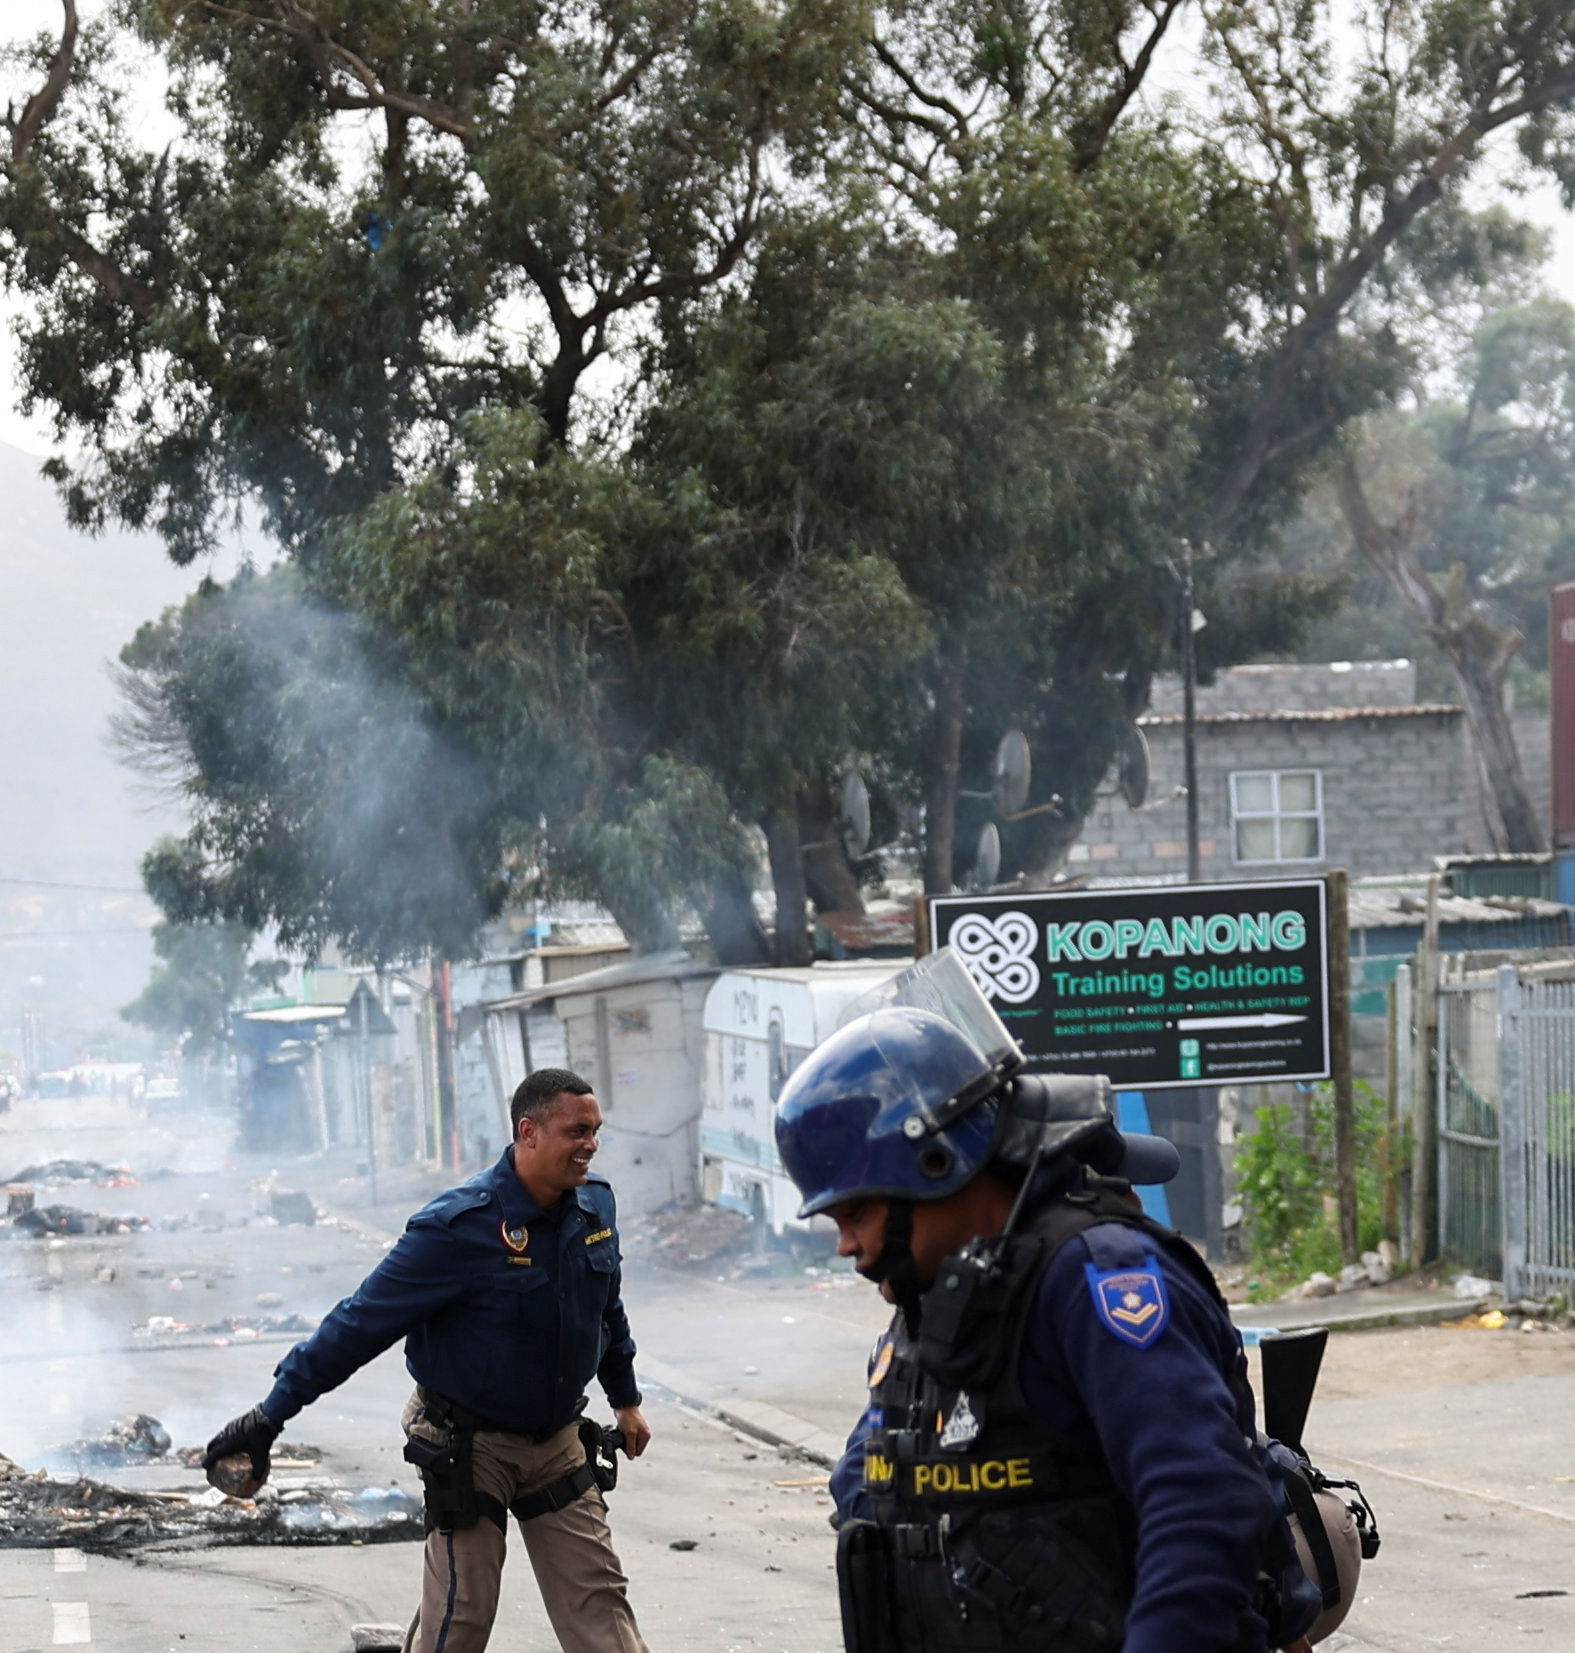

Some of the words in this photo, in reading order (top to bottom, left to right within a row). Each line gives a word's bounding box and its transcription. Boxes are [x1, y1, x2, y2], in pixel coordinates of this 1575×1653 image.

[1046, 910, 1306, 963] KOPANONG
[1052, 969, 1165, 998] Training
[1173, 963, 1304, 990] Solutions
[1054, 1008, 1084, 1019] FOOD
[1086, 1005, 1124, 1018] SAFETY
[1136, 1003, 1164, 1014] FIRST
[1167, 1002, 1185, 1013] AID
[1196, 1000, 1235, 1012] HEALTH
[1247, 997, 1286, 1009] SAFETY
[1054, 1024, 1085, 1036] BASIC
[1089, 1022, 1111, 1034] FIRE
[1114, 1020, 1163, 1033] FIGHTING
[914, 1458, 1033, 1495] POLICE
